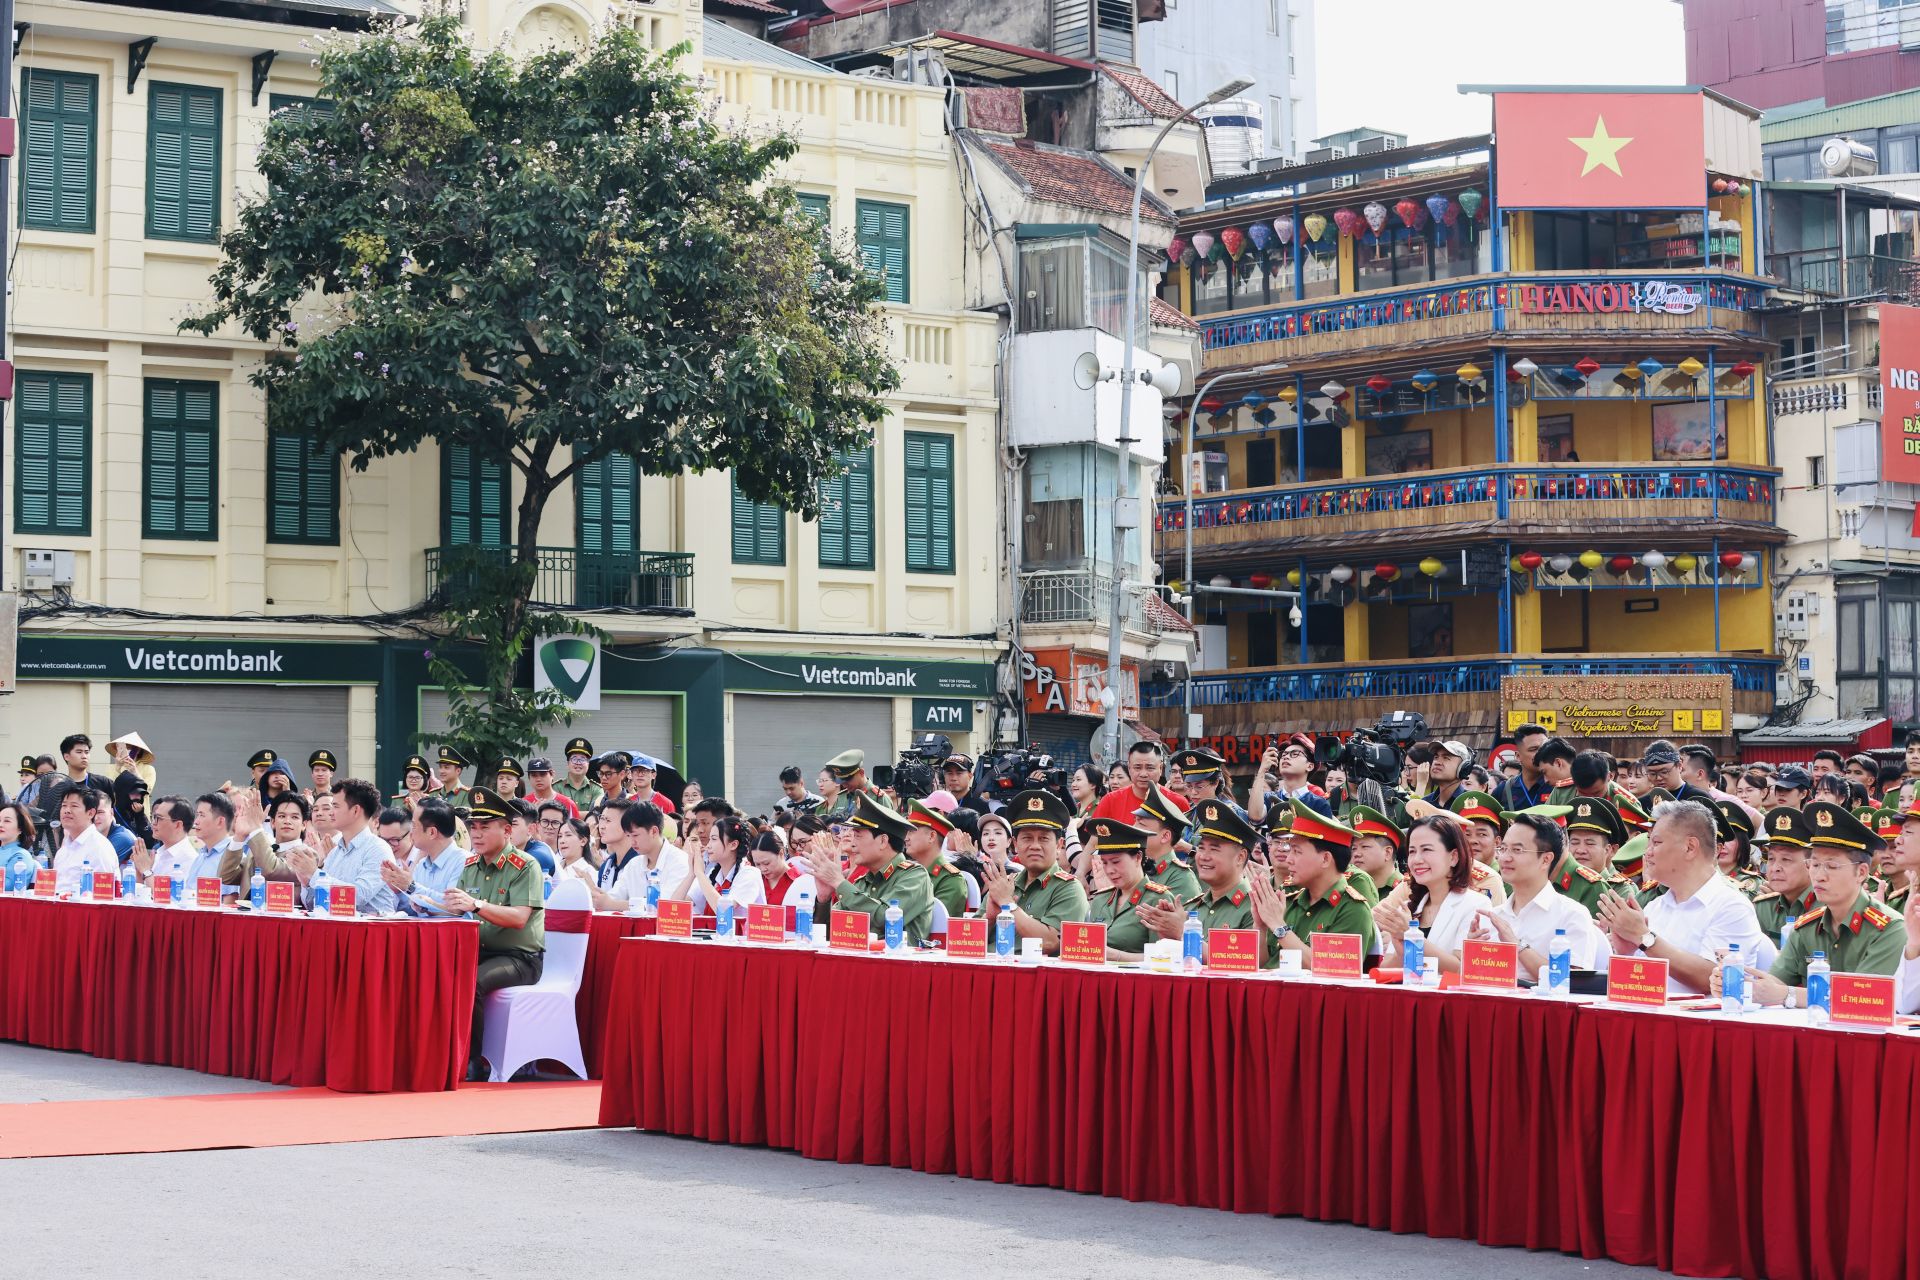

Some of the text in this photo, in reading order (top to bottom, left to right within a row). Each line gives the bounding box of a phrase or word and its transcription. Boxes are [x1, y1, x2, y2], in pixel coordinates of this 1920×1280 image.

[1520, 281, 1702, 313] HANOI Premium
[21, 661, 107, 670] www.vietcombank.com.vn
[125, 647, 283, 672] Vietcombank
[801, 664, 917, 687] Vietcombank
[1504, 679, 1725, 702] HANOI SQUARE RESTAURANT
[926, 706, 963, 723] ATM
[1563, 704, 1665, 717] Vietnamese Cuisine
[1571, 720, 1659, 736] Vegetarian Food
[1495, 960, 1508, 968] ANH
[1841, 994, 1884, 1006] LÊ THỊ ÁNH MAI
